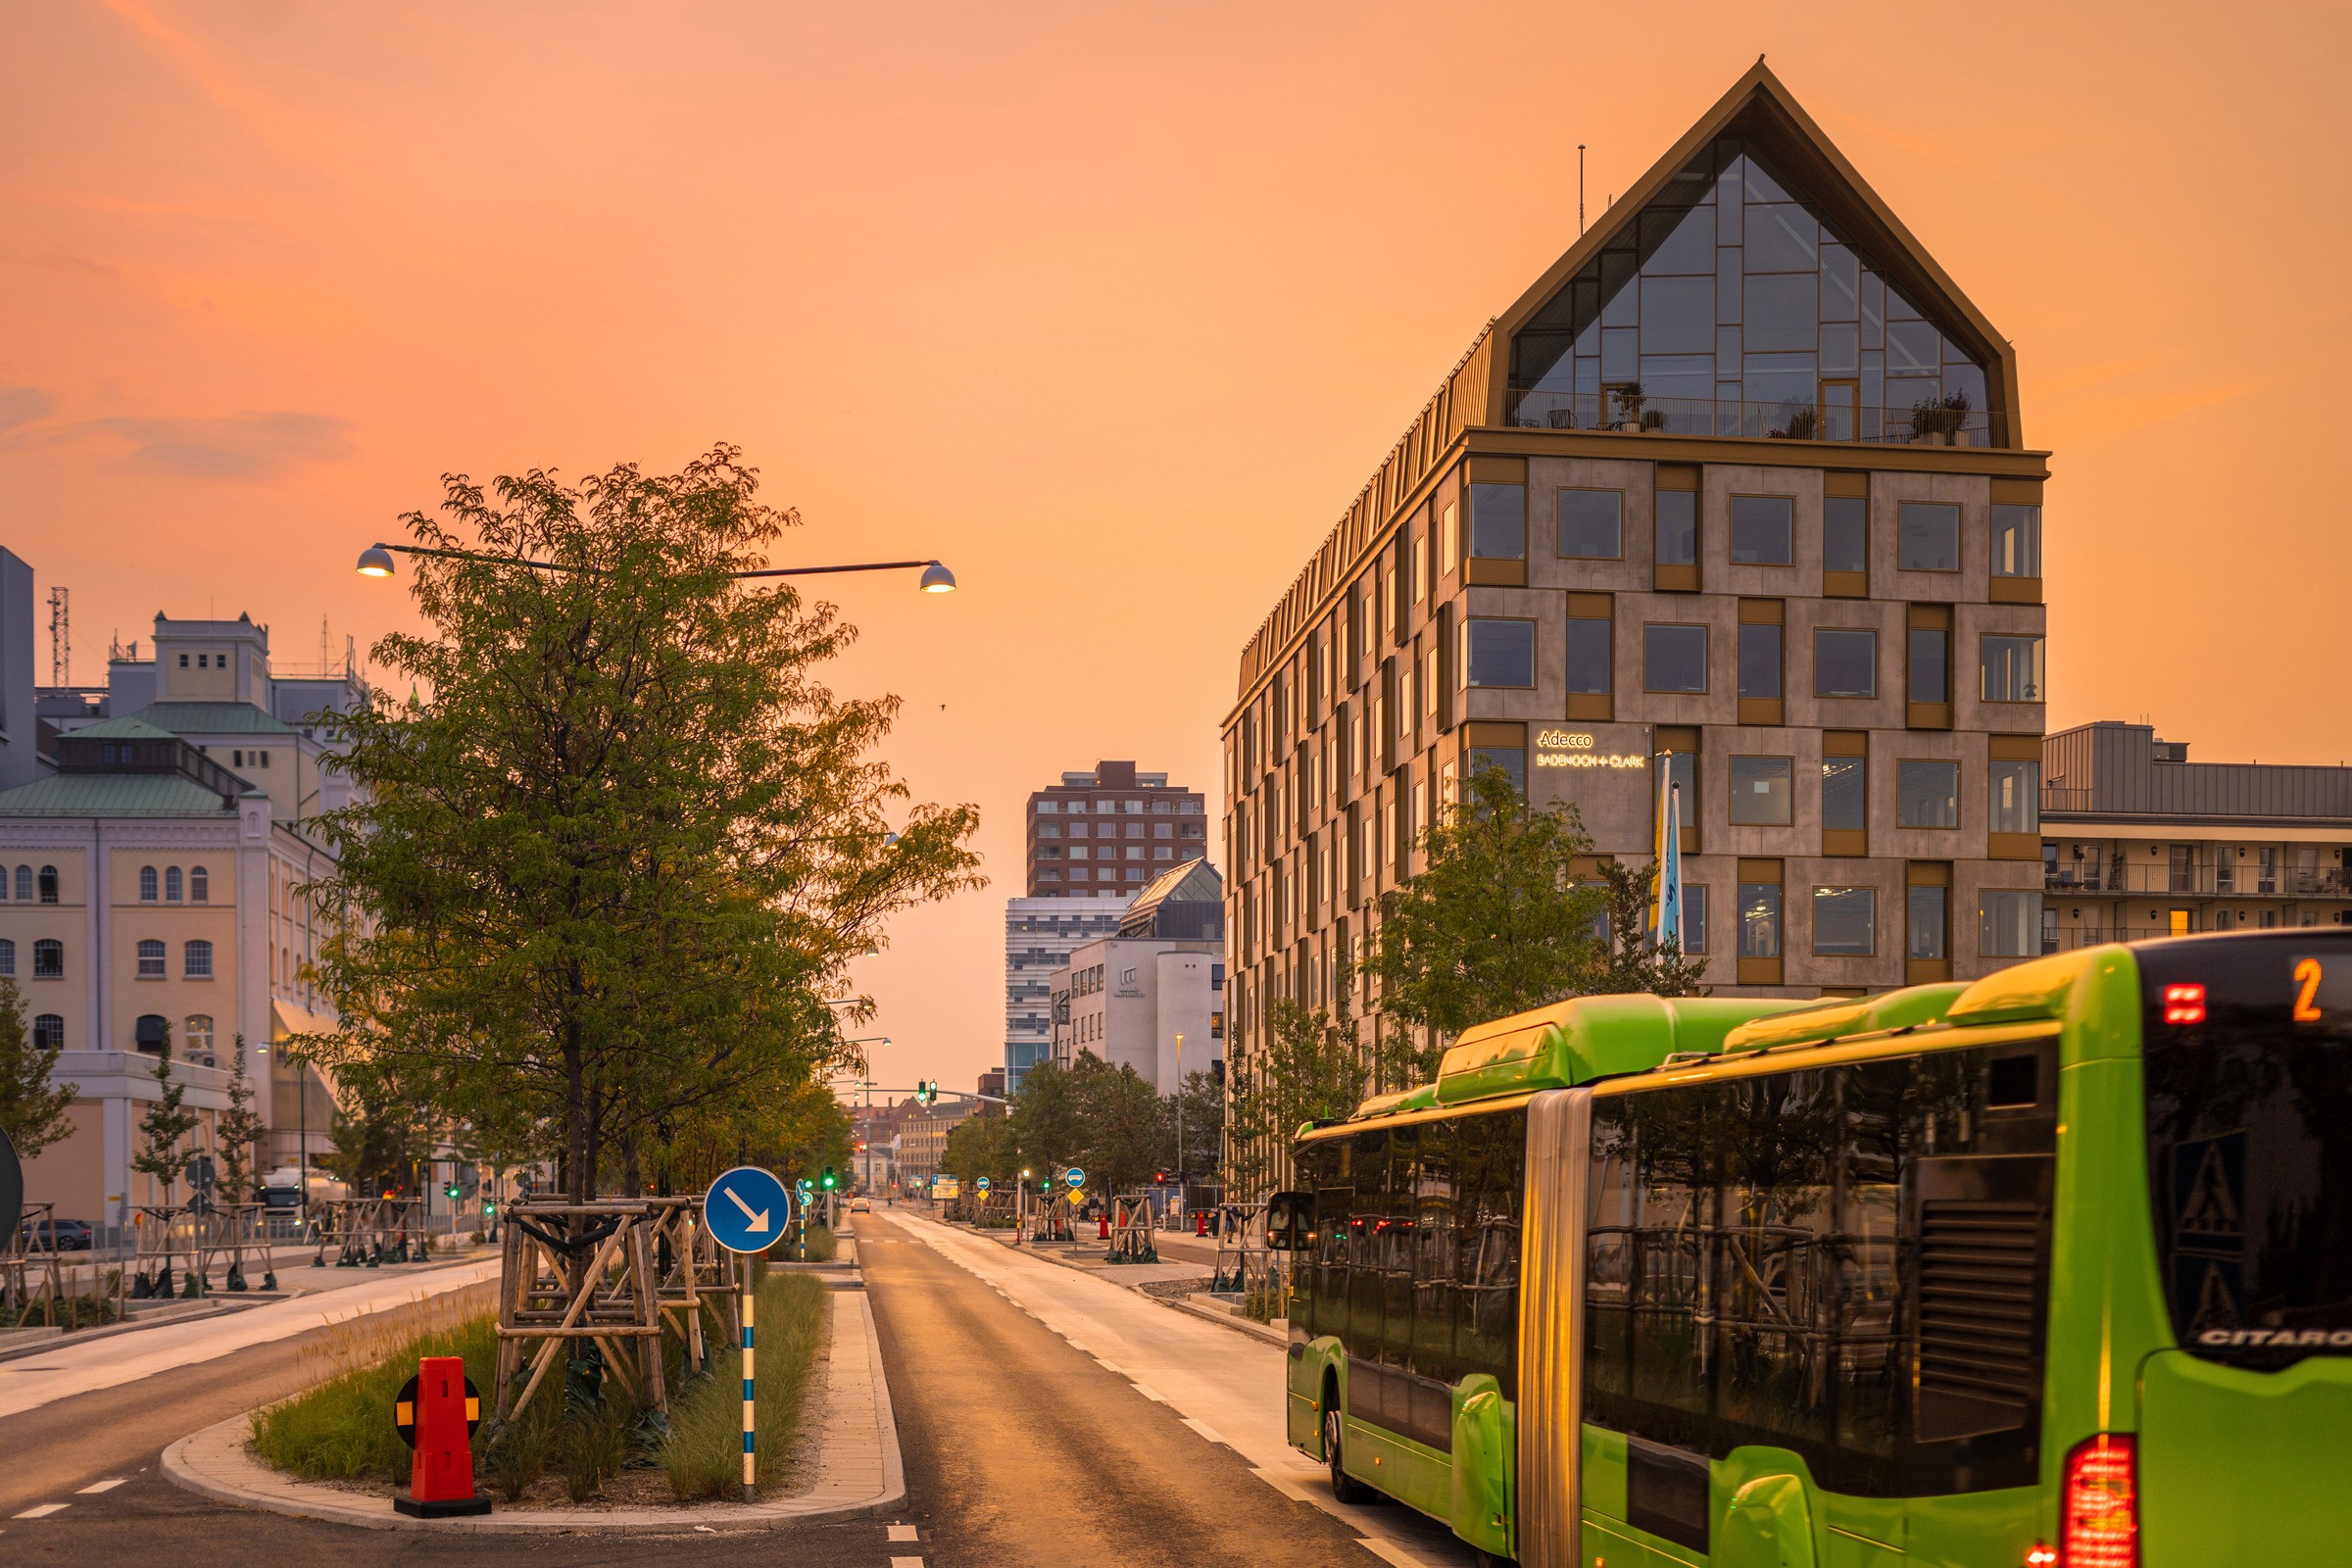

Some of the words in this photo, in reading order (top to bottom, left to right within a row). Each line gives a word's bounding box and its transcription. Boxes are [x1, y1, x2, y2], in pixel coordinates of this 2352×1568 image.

[1539, 730, 1592, 747] Adecco
[1538, 755, 1596, 766] BADENOCH
[1609, 756, 1644, 767] CLARK
[2293, 957, 2322, 1021] 2
[2199, 1330, 2352, 1346] CITARO
